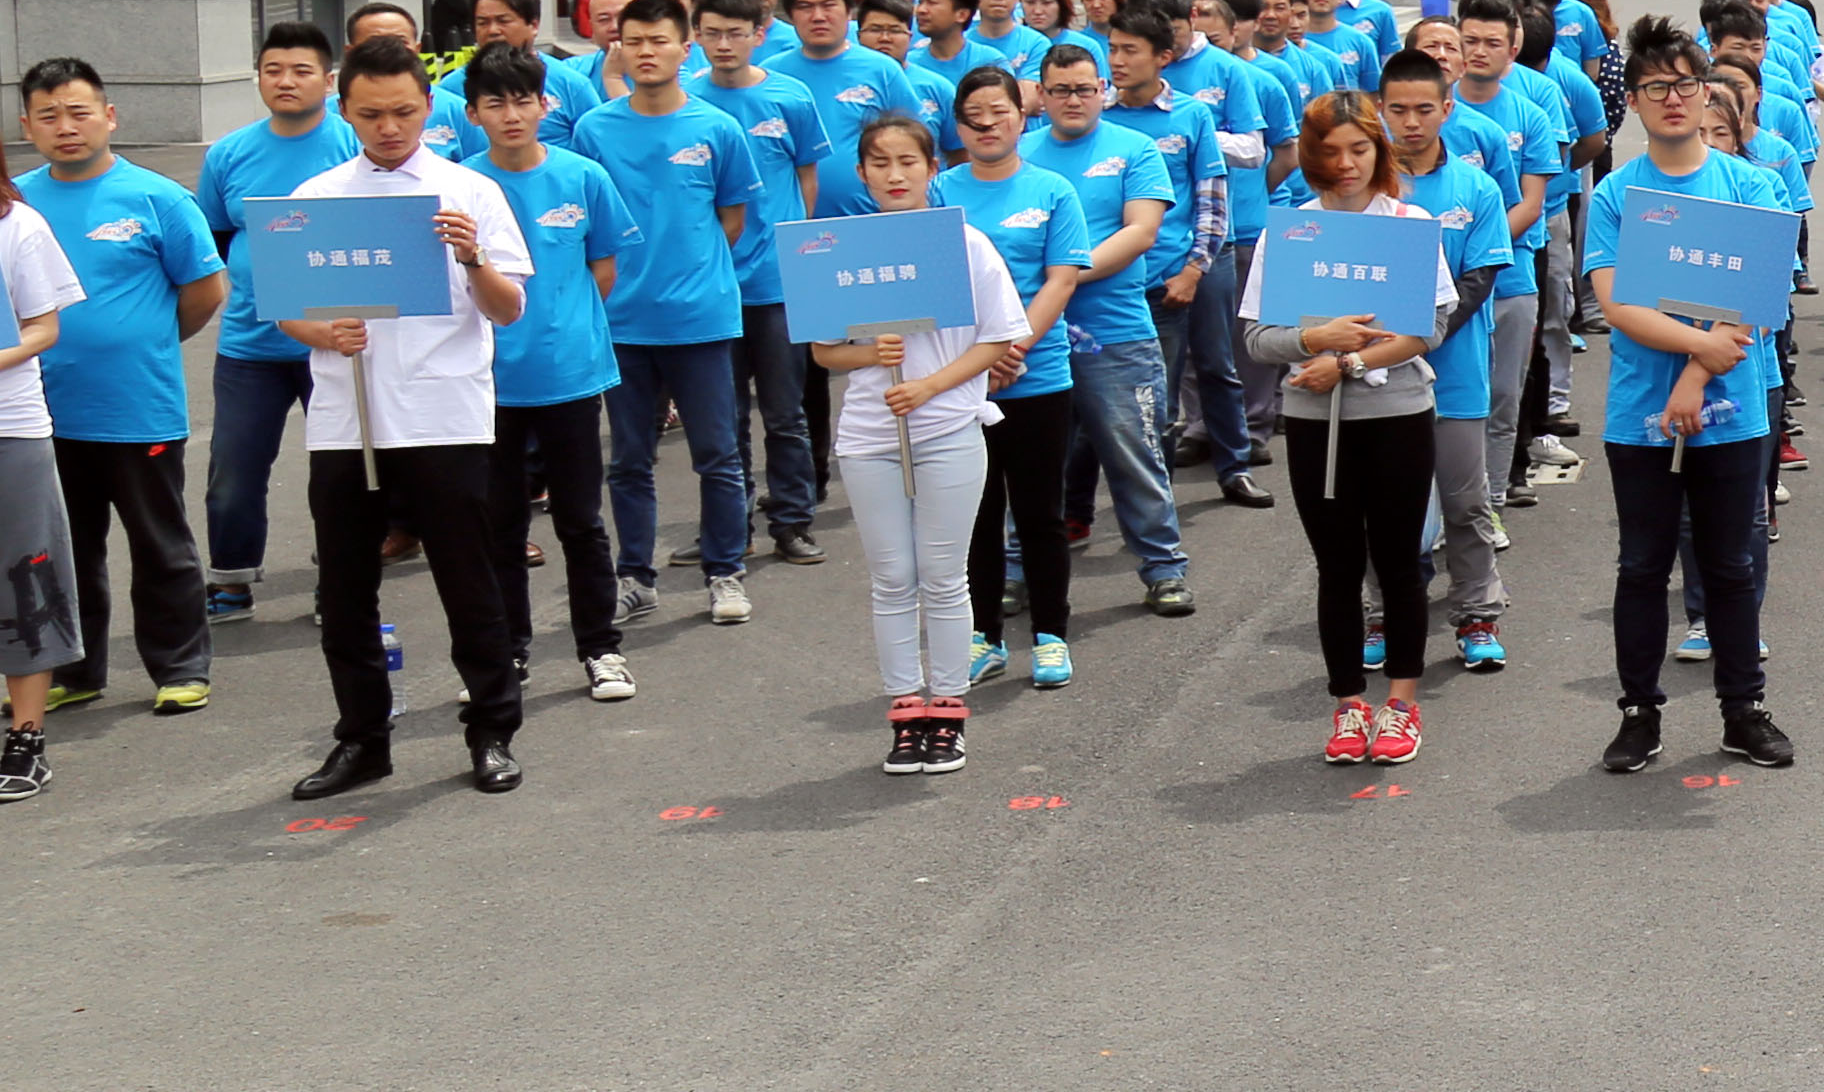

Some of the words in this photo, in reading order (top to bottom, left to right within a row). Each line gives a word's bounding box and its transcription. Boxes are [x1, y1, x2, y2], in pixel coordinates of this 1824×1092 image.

[306, 249, 393, 267] 协通福茂
[1668, 245, 1744, 271] 协通丰田
[1312, 261, 1388, 282] 协通百联
[1681, 774, 1742, 789] 16
[1349, 783, 1413, 799] 17
[1007, 795, 1069, 811] 18
[658, 805, 724, 821] 19
[284, 815, 369, 833] 20
